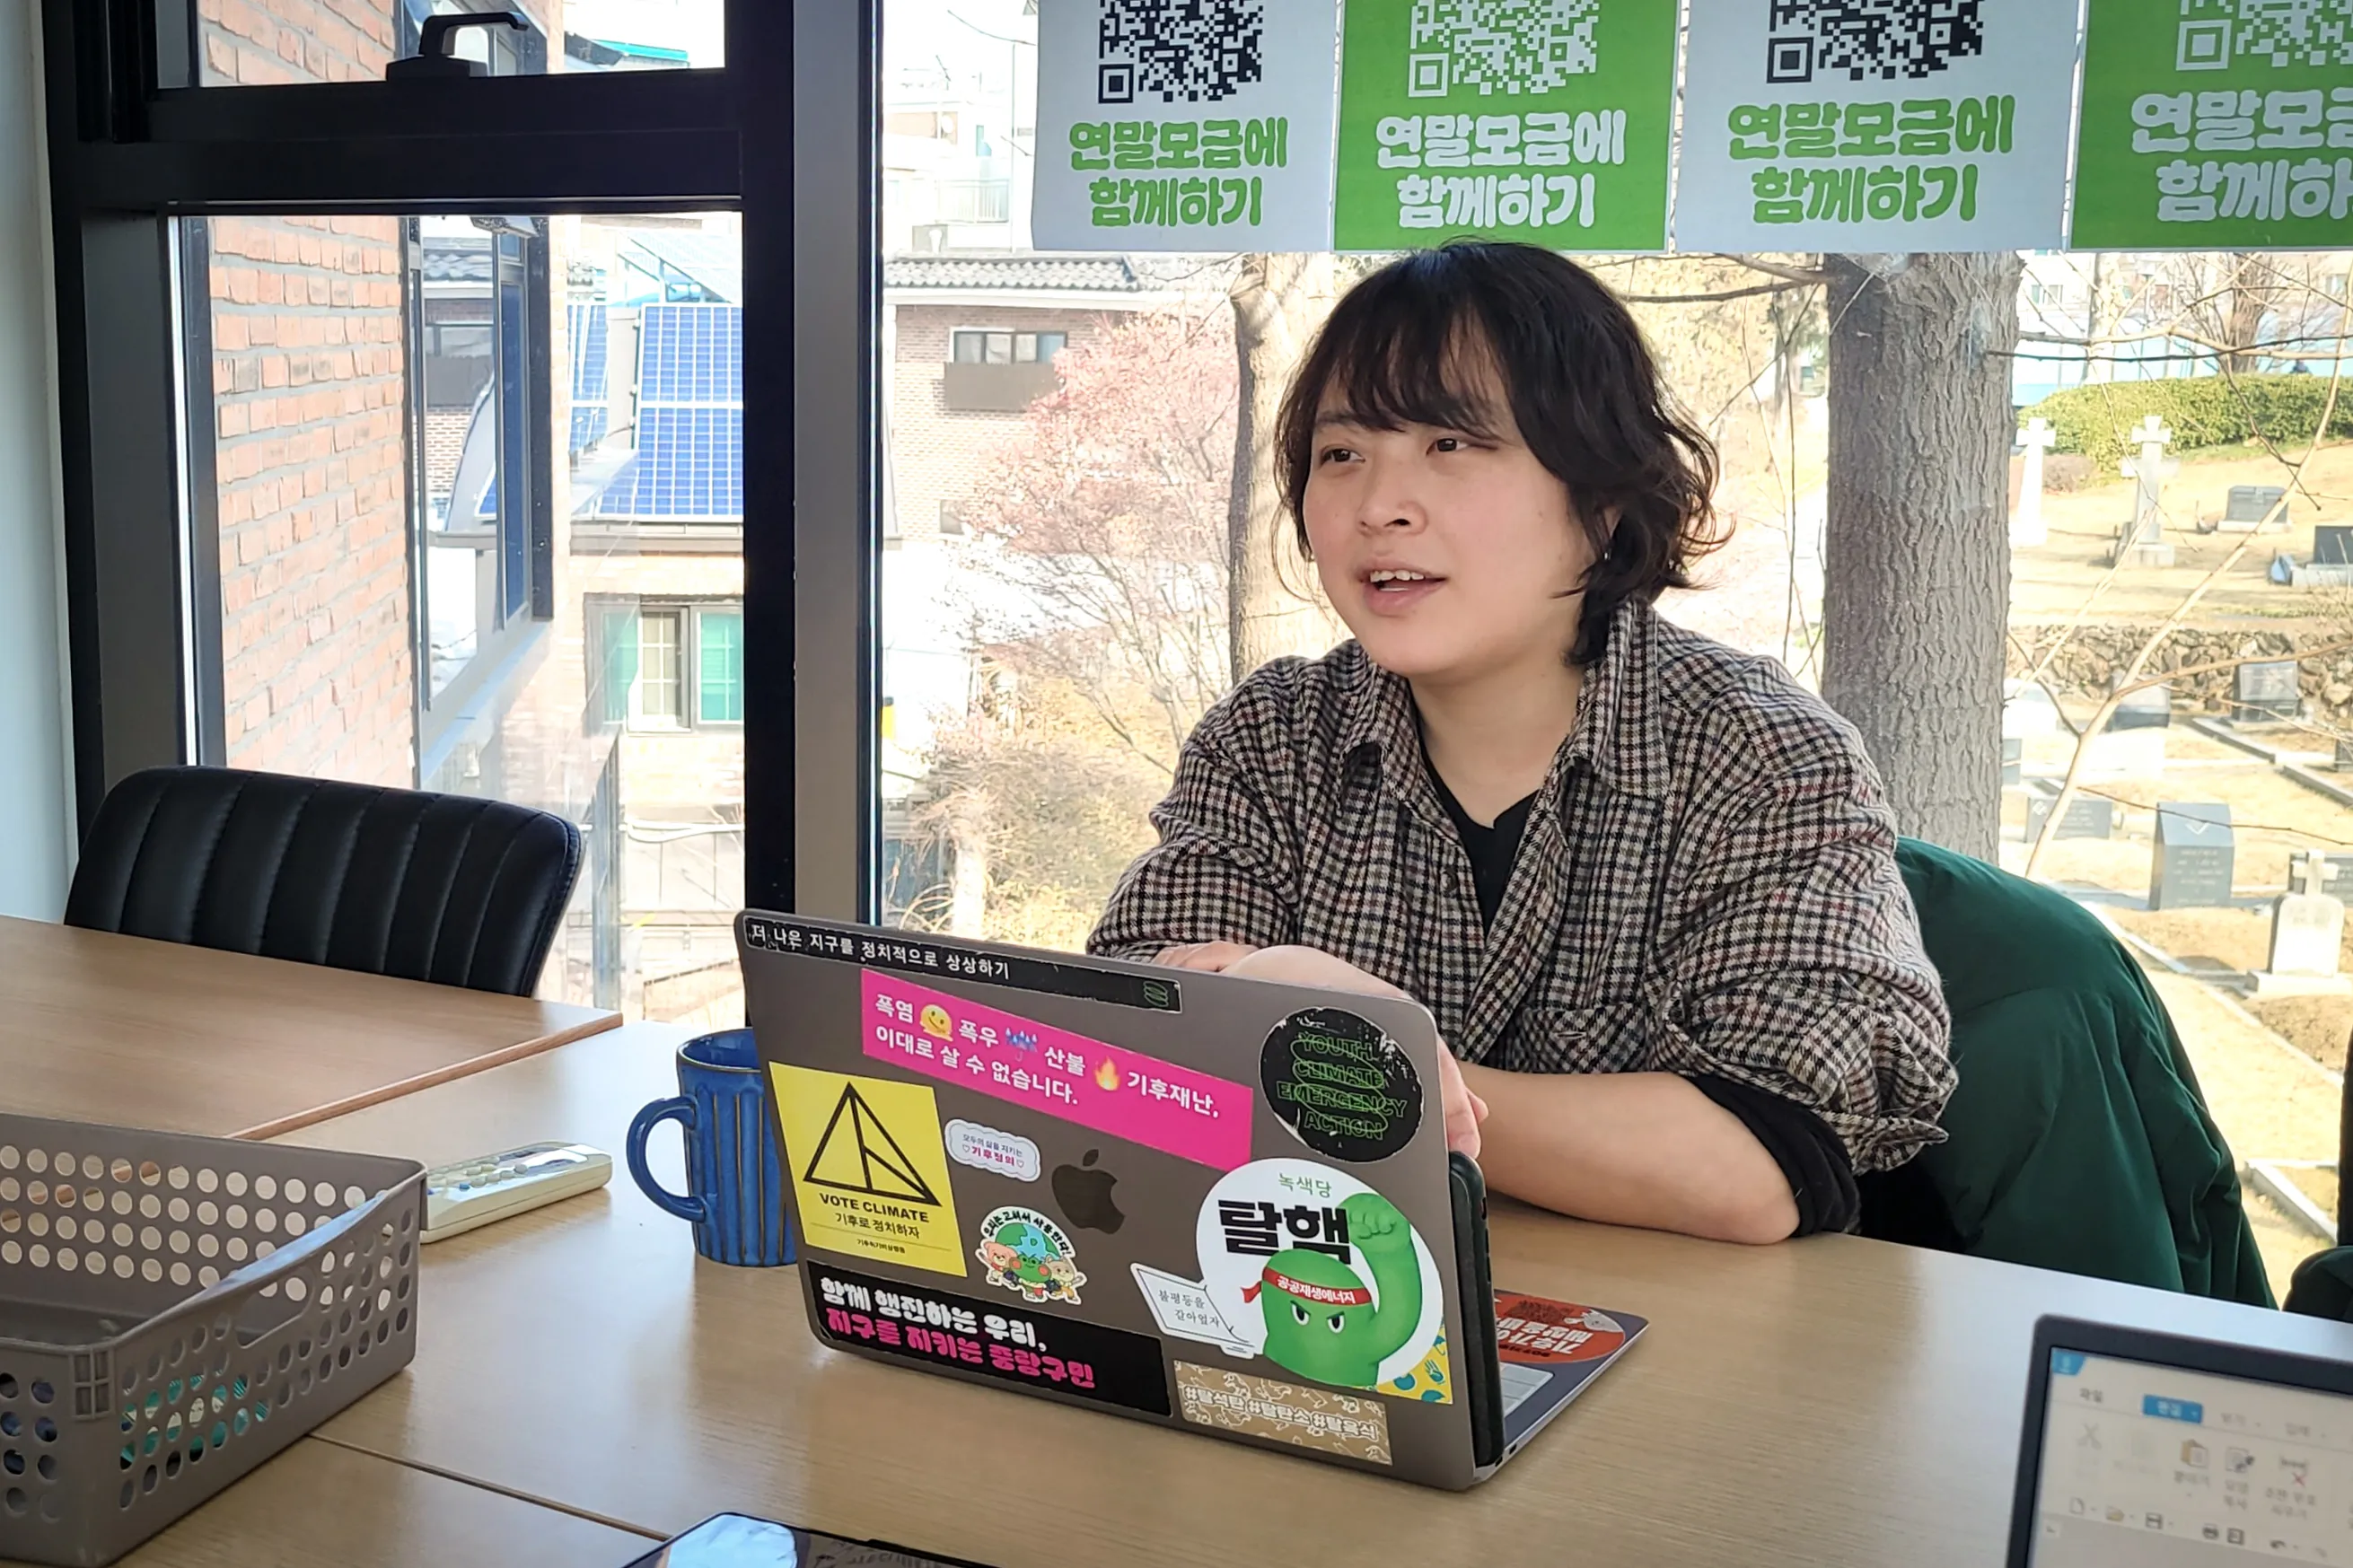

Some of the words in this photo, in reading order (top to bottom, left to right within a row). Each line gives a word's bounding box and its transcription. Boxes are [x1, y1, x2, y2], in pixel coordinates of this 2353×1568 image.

[1068, 117, 1288, 171] 연말모금에
[1375, 109, 1627, 168] 연말모금에
[1727, 95, 2016, 160] 연말모금에
[1089, 176, 1263, 227] 함께하기
[1397, 172, 1596, 229] 함께하기
[1751, 164, 1980, 224] 함께하기
[751, 924, 768, 943] 더
[773, 928, 803, 951] 나은
[809, 931, 854, 956] 지구를
[861, 941, 939, 968] 정치적으로
[945, 952, 1011, 980] 상상하기
[874, 994, 914, 1024] 폭염
[958, 1019, 999, 1048] 폭우
[1044, 1045, 1086, 1076] 산불
[1127, 1071, 1221, 1118] 기후재난,
[875, 1025, 935, 1060] 이대로
[940, 1045, 961, 1069] 살
[965, 1054, 986, 1074] 수
[991, 1061, 1079, 1106] 없습니다.
[1298, 1032, 1374, 1061] YOUTH
[1295, 1060, 1384, 1089] CLIMATE
[1276, 1081, 1408, 1117] EMERGENCY
[962, 1133, 985, 1147] 모두의
[1001, 1143, 1023, 1157] 지키는
[1304, 1111, 1383, 1141] ACTION
[971, 1145, 1015, 1166] 기후정의
[1278, 1172, 1332, 1199] 녹색당
[819, 1193, 860, 1211] VOTE
[863, 1201, 930, 1223] CLIMATE
[835, 1213, 871, 1230] 기후로
[873, 1219, 920, 1240] 정치하자
[1217, 1199, 1352, 1266] 탈핵
[1158, 1289, 1206, 1310] 불평등을
[1277, 1275, 1356, 1304] 공공재생에너지
[820, 1276, 872, 1312] 함께
[874, 1288, 978, 1333] 행진하는
[983, 1314, 1048, 1353] 우리,
[1174, 1309, 1220, 1327] 갈아엎자
[825, 1307, 901, 1346] 지구를
[904, 1324, 984, 1364] 지키는
[988, 1344, 1096, 1389] 중랑구민
[1183, 1384, 1247, 1412] #탈석탄
[1247, 1399, 1311, 1426] #탈탄소
